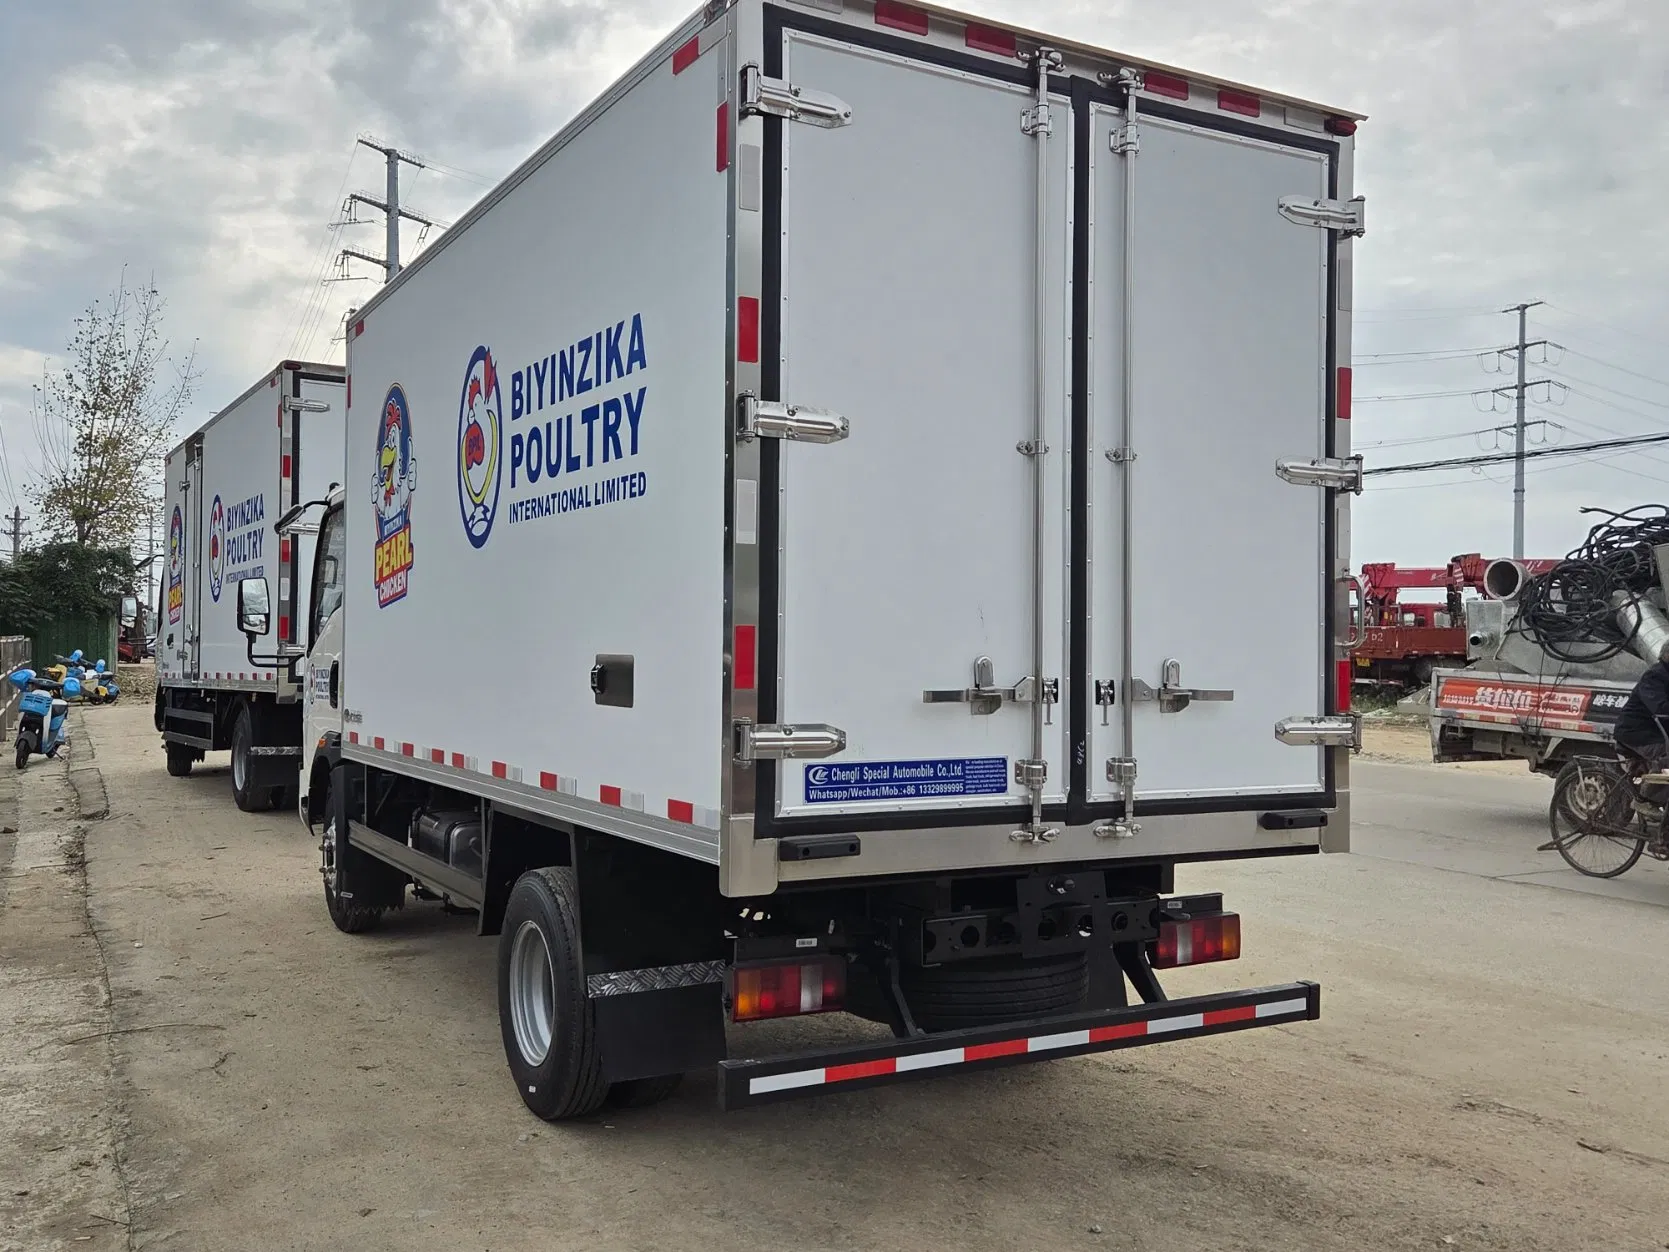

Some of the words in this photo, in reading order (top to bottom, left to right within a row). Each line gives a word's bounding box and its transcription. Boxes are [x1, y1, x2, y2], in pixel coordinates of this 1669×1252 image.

[511, 312, 647, 422] BIYINZIKA
[510, 386, 647, 489] POULTRY
[227, 493, 264, 532] BIYINZIKA
[509, 488, 592, 524] INTERNATIONAL
[594, 471, 647, 506] LIMITED
[227, 527, 265, 566] POULTRY
[376, 528, 412, 582] PEARL
[379, 569, 407, 601] CHICKEN
[831, 766, 860, 784] Chengli
[863, 765, 890, 782] Special
[893, 763, 934, 780] Automobile
